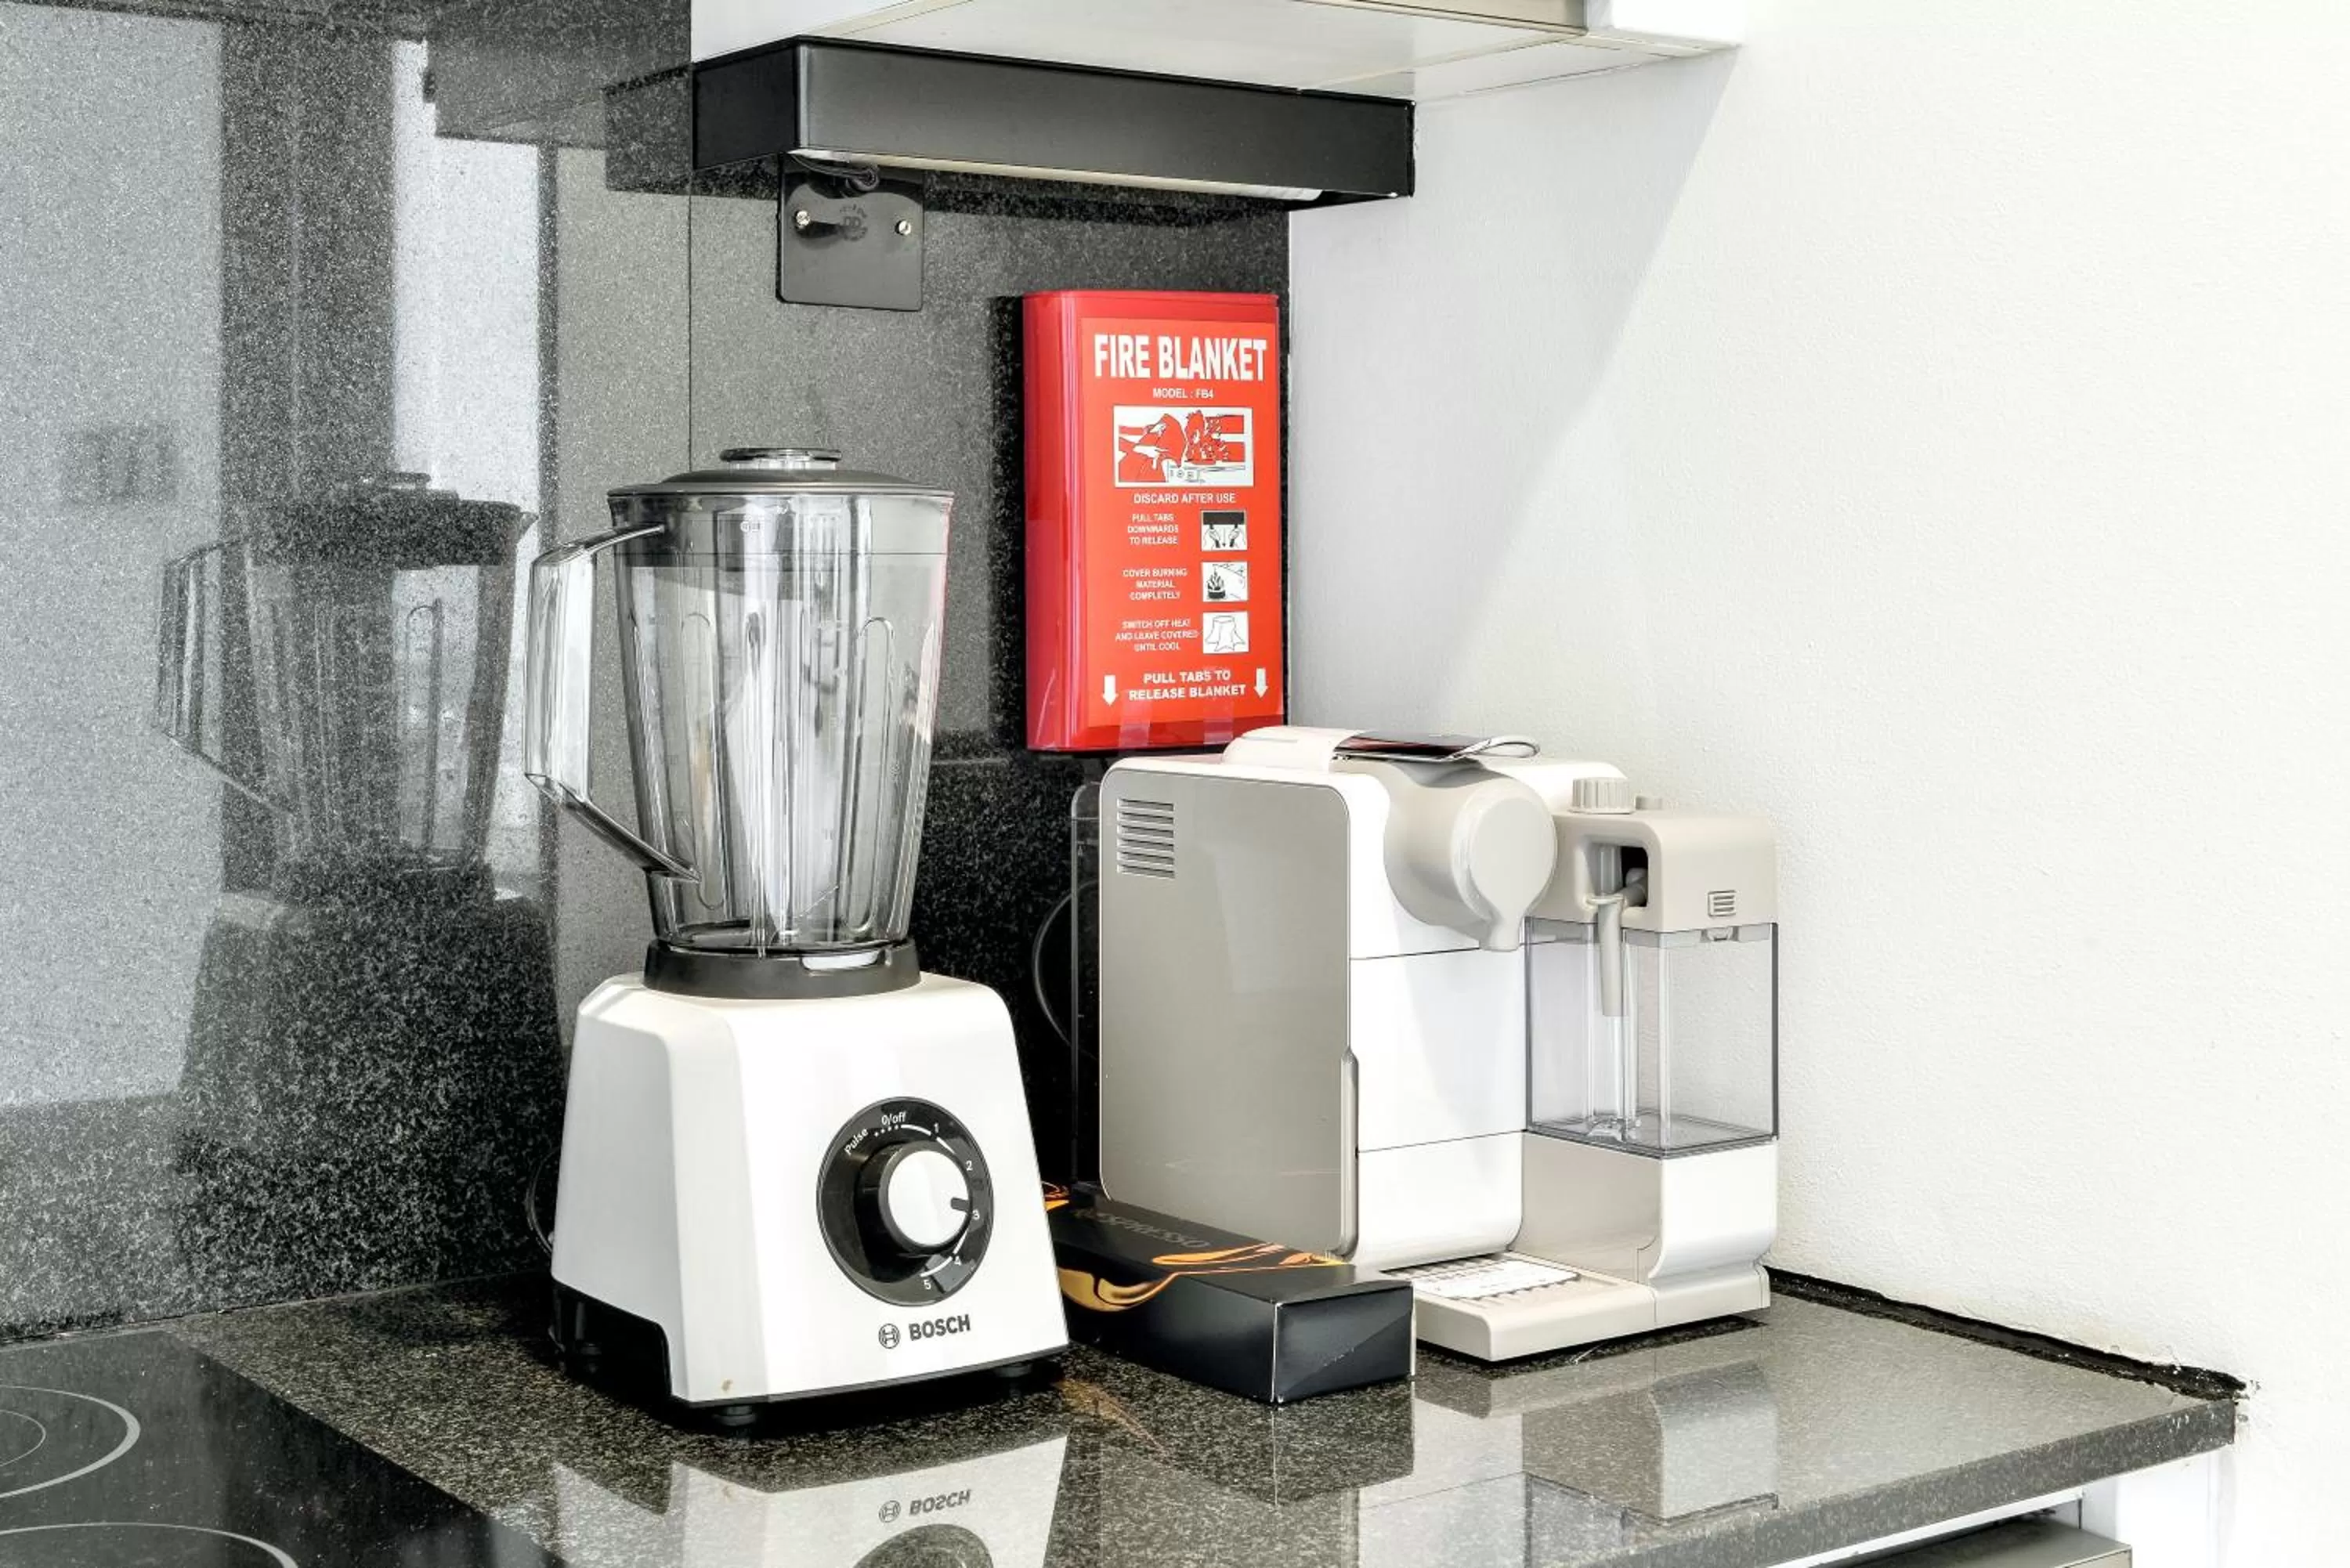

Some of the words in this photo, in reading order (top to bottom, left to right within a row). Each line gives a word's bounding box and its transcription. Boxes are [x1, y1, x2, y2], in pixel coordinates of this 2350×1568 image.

[1094, 334, 1151, 378] FIRE
[1158, 335, 1267, 381] BLANKET
[1153, 388, 1188, 398] MODEL
[1196, 389, 1214, 399] FB4
[1134, 493, 1178, 504] DISCARD
[1182, 493, 1213, 503] AFTER
[1216, 493, 1235, 503] USE
[1128, 525, 1178, 533] DOWNWARDS
[1142, 536, 1178, 544] RELEASE
[1123, 569, 1150, 577] COVER
[1152, 568, 1188, 576] BURNING
[1130, 591, 1180, 600] COMPLETELY
[1122, 620, 1153, 629] SWITCH
[1115, 632, 1133, 641] AND
[1134, 643, 1156, 652] UNTIL
[1143, 672, 1175, 684] PULL
[1180, 671, 1210, 682] TABS
[1215, 670, 1231, 681] TO
[1129, 688, 1185, 700] RELEASE
[1189, 685, 1246, 698] BLANKET
[934, 1123, 939, 1133] 1
[844, 1128, 869, 1156] Pulse
[966, 1161, 973, 1171] 2
[972, 1209, 980, 1219] 3
[954, 1255, 962, 1266] 4
[924, 1280, 931, 1290] 5
[909, 1314, 971, 1341] BOSCH
